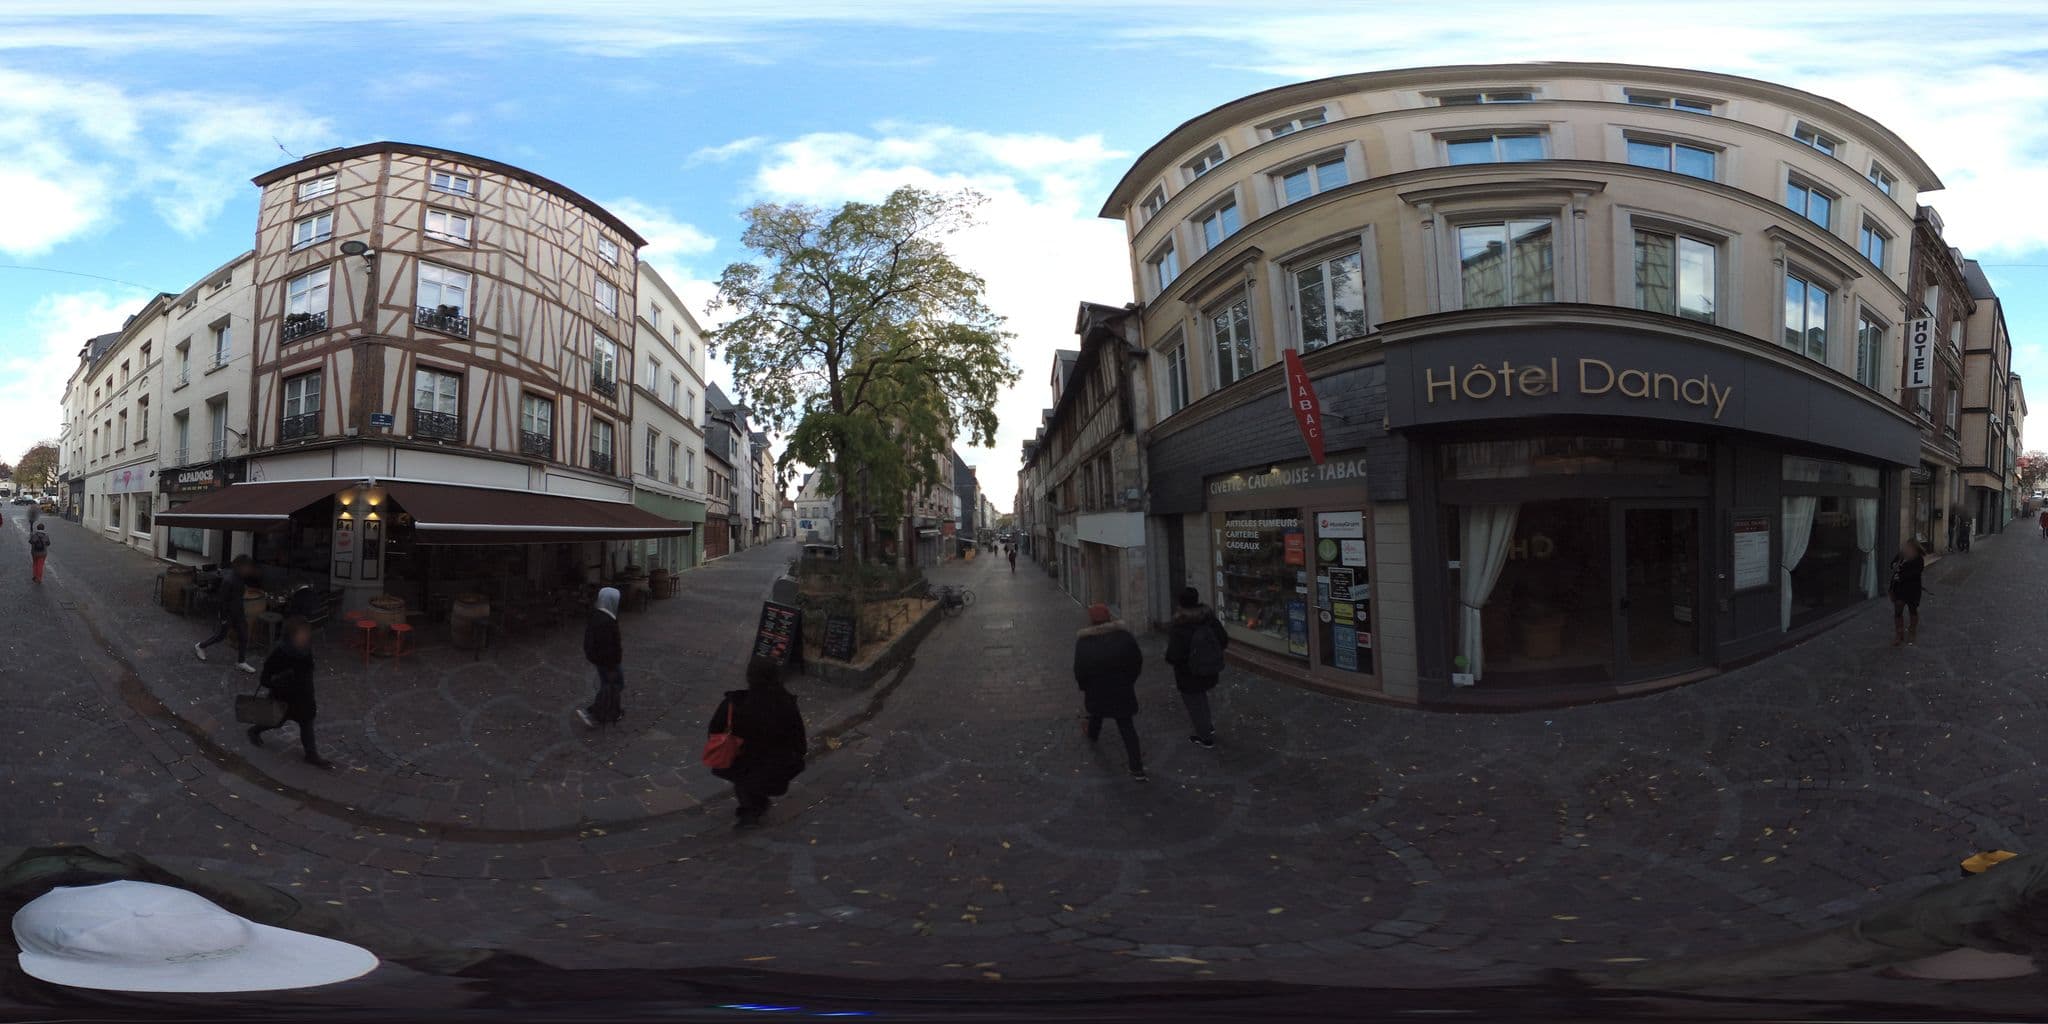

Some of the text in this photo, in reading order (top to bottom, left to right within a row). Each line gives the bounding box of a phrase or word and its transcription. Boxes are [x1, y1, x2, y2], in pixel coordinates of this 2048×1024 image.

[1913, 320, 1928, 384] HOTEL
[1295, 374, 1318, 438] TABAC
[1426, 356, 1732, 419] Hôtel Dandy
[1317, 459, 1367, 481] TABAC
[1225, 518, 1298, 528] ARTICLES FUMEURS
[1225, 541, 1260, 550] CADEAUX
[1215, 528, 1225, 626] TABAC
